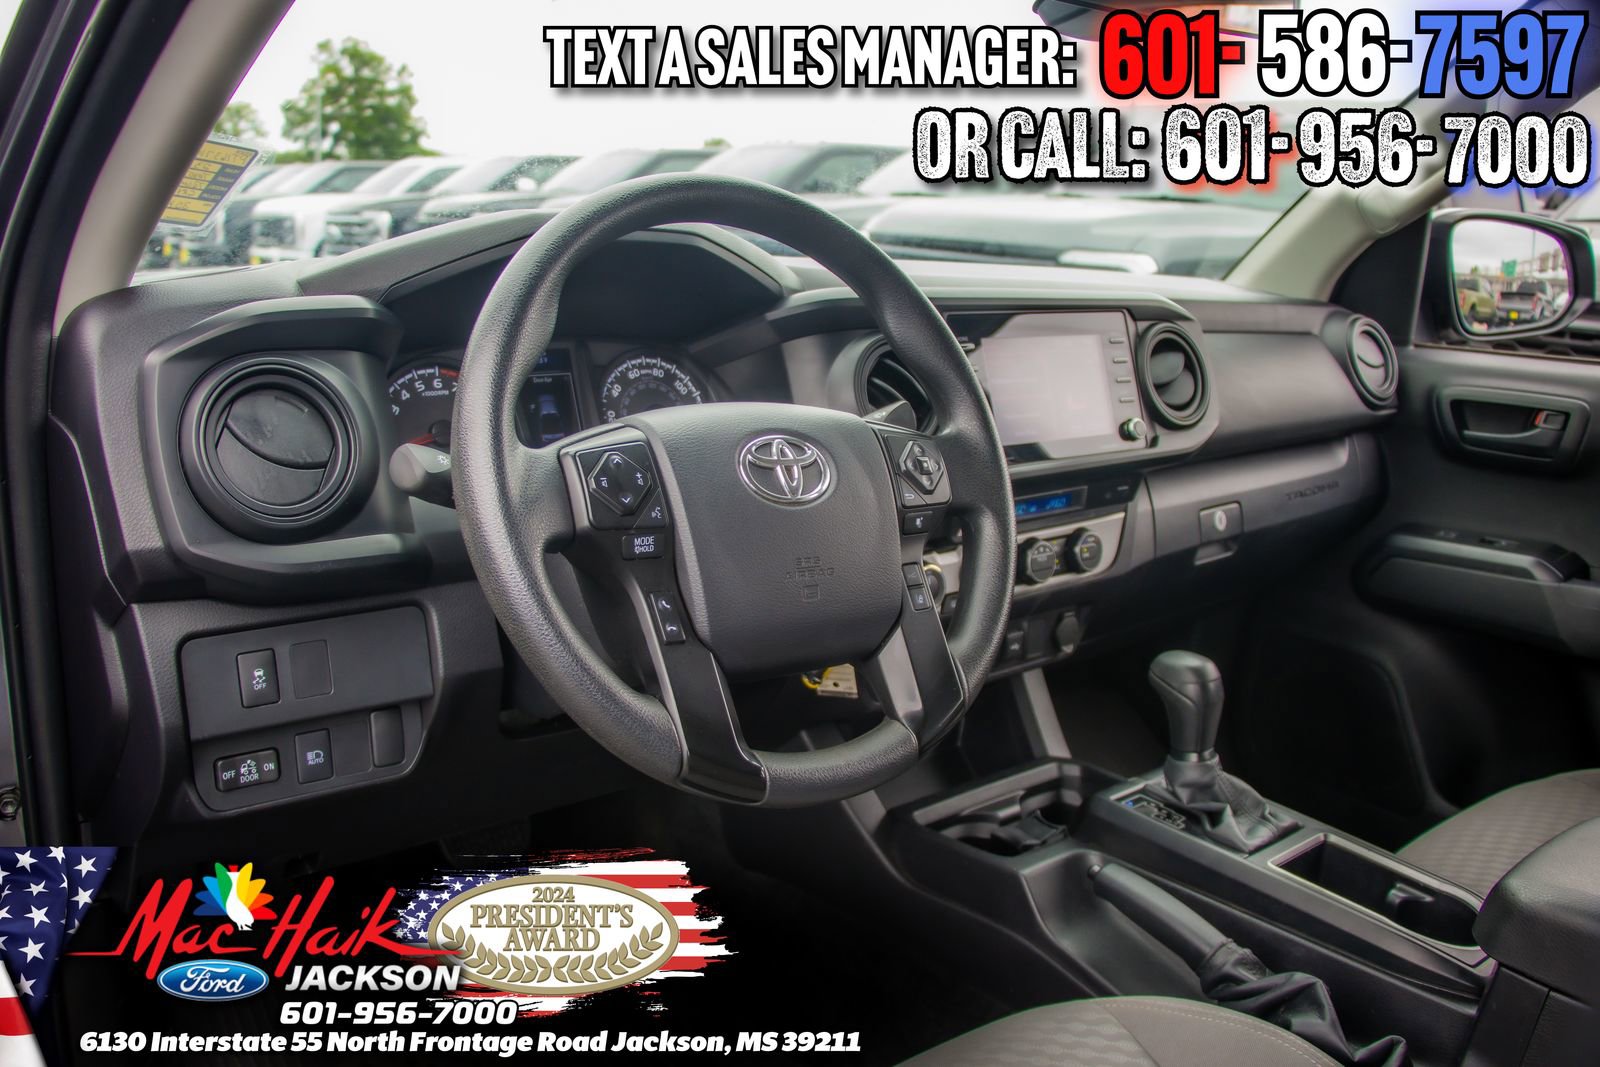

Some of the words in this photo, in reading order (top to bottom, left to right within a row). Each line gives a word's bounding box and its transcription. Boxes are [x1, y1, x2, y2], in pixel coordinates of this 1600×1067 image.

[628, 368, 640, 380] 60
[652, 367, 664, 378] 80
[414, 380, 425, 392] 5
[433, 378, 443, 389] 6
[674, 380, 688, 395] 100
[401, 389, 410, 400] 4
[612, 384, 622, 398] 40
[634, 535, 655, 546] MODE
[253, 682, 267, 691] OFF
[307, 758, 324, 766] AUTO
[222, 769, 236, 780] OFF
[263, 762, 275, 772] ON
[240, 773, 259, 783] DOOR
